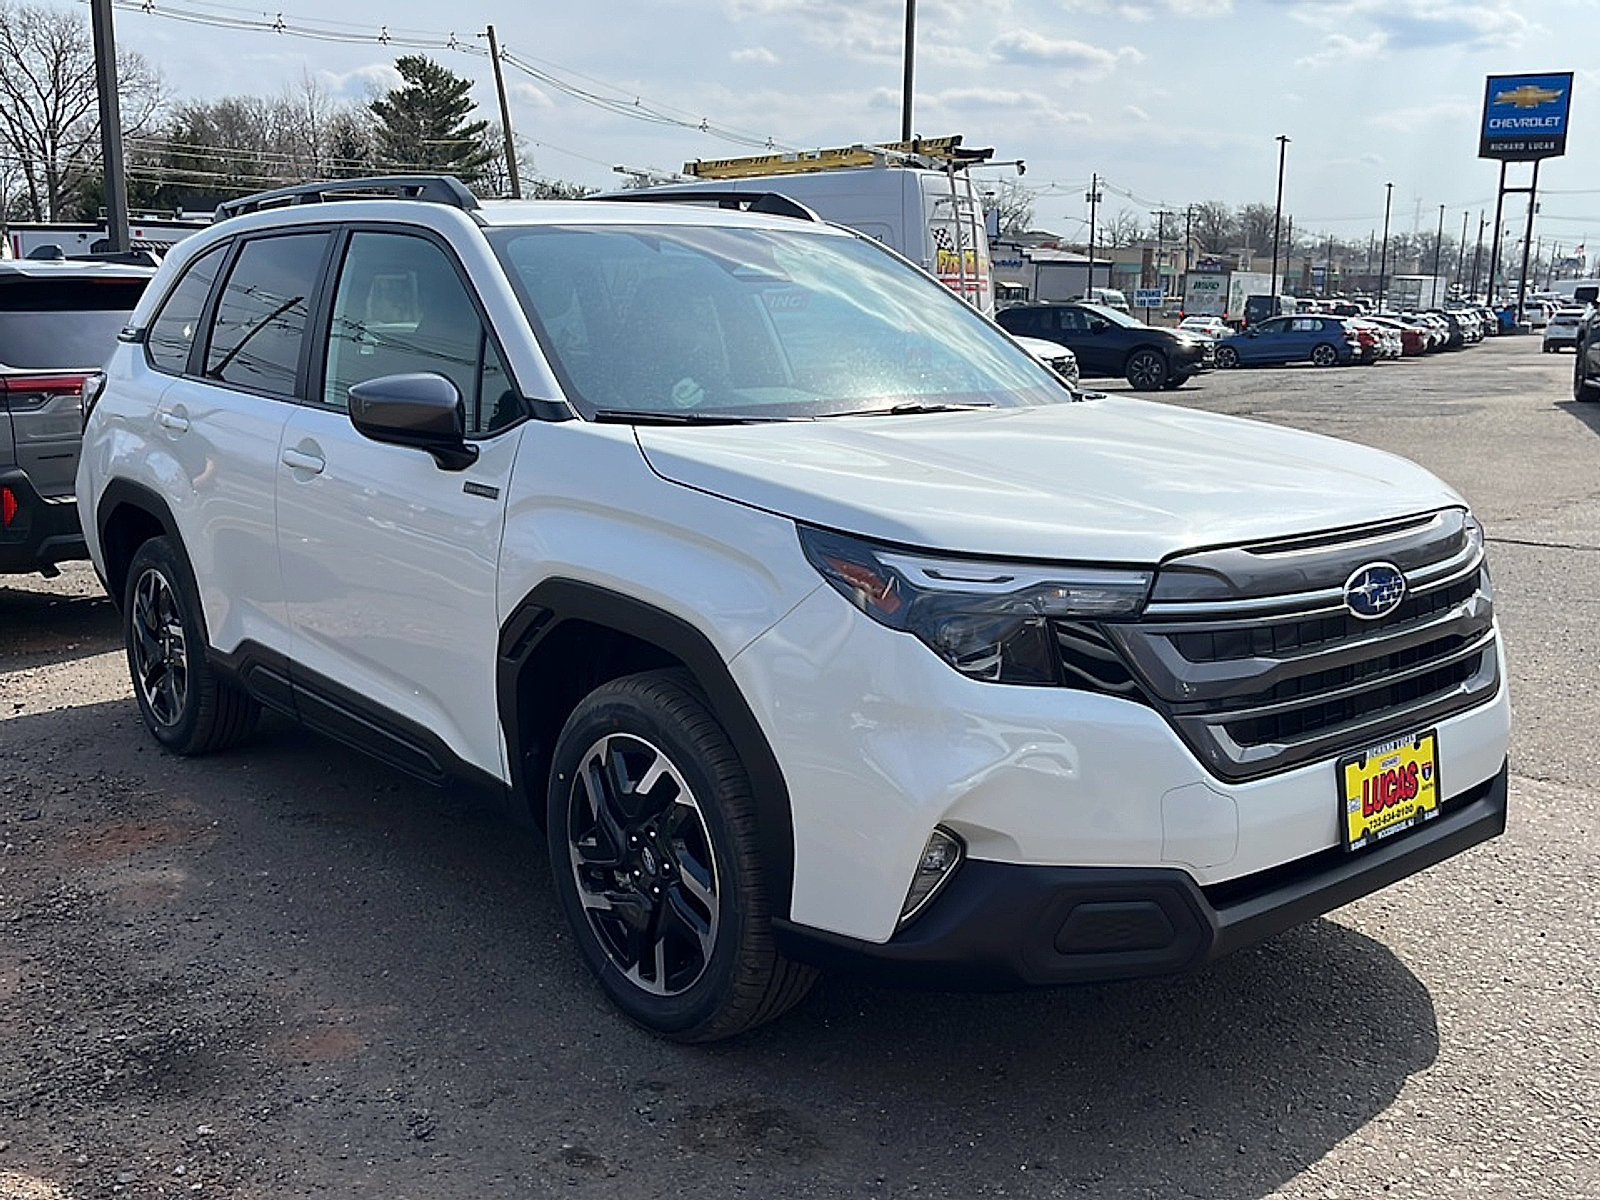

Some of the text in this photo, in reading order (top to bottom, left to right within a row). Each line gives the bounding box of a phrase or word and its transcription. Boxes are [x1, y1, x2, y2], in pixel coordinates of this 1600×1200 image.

[1489, 117, 1561, 129] CHEVROLET
[1490, 141, 1555, 151] RICHARD LUCAS
[1362, 761, 1419, 818] LUCAS
